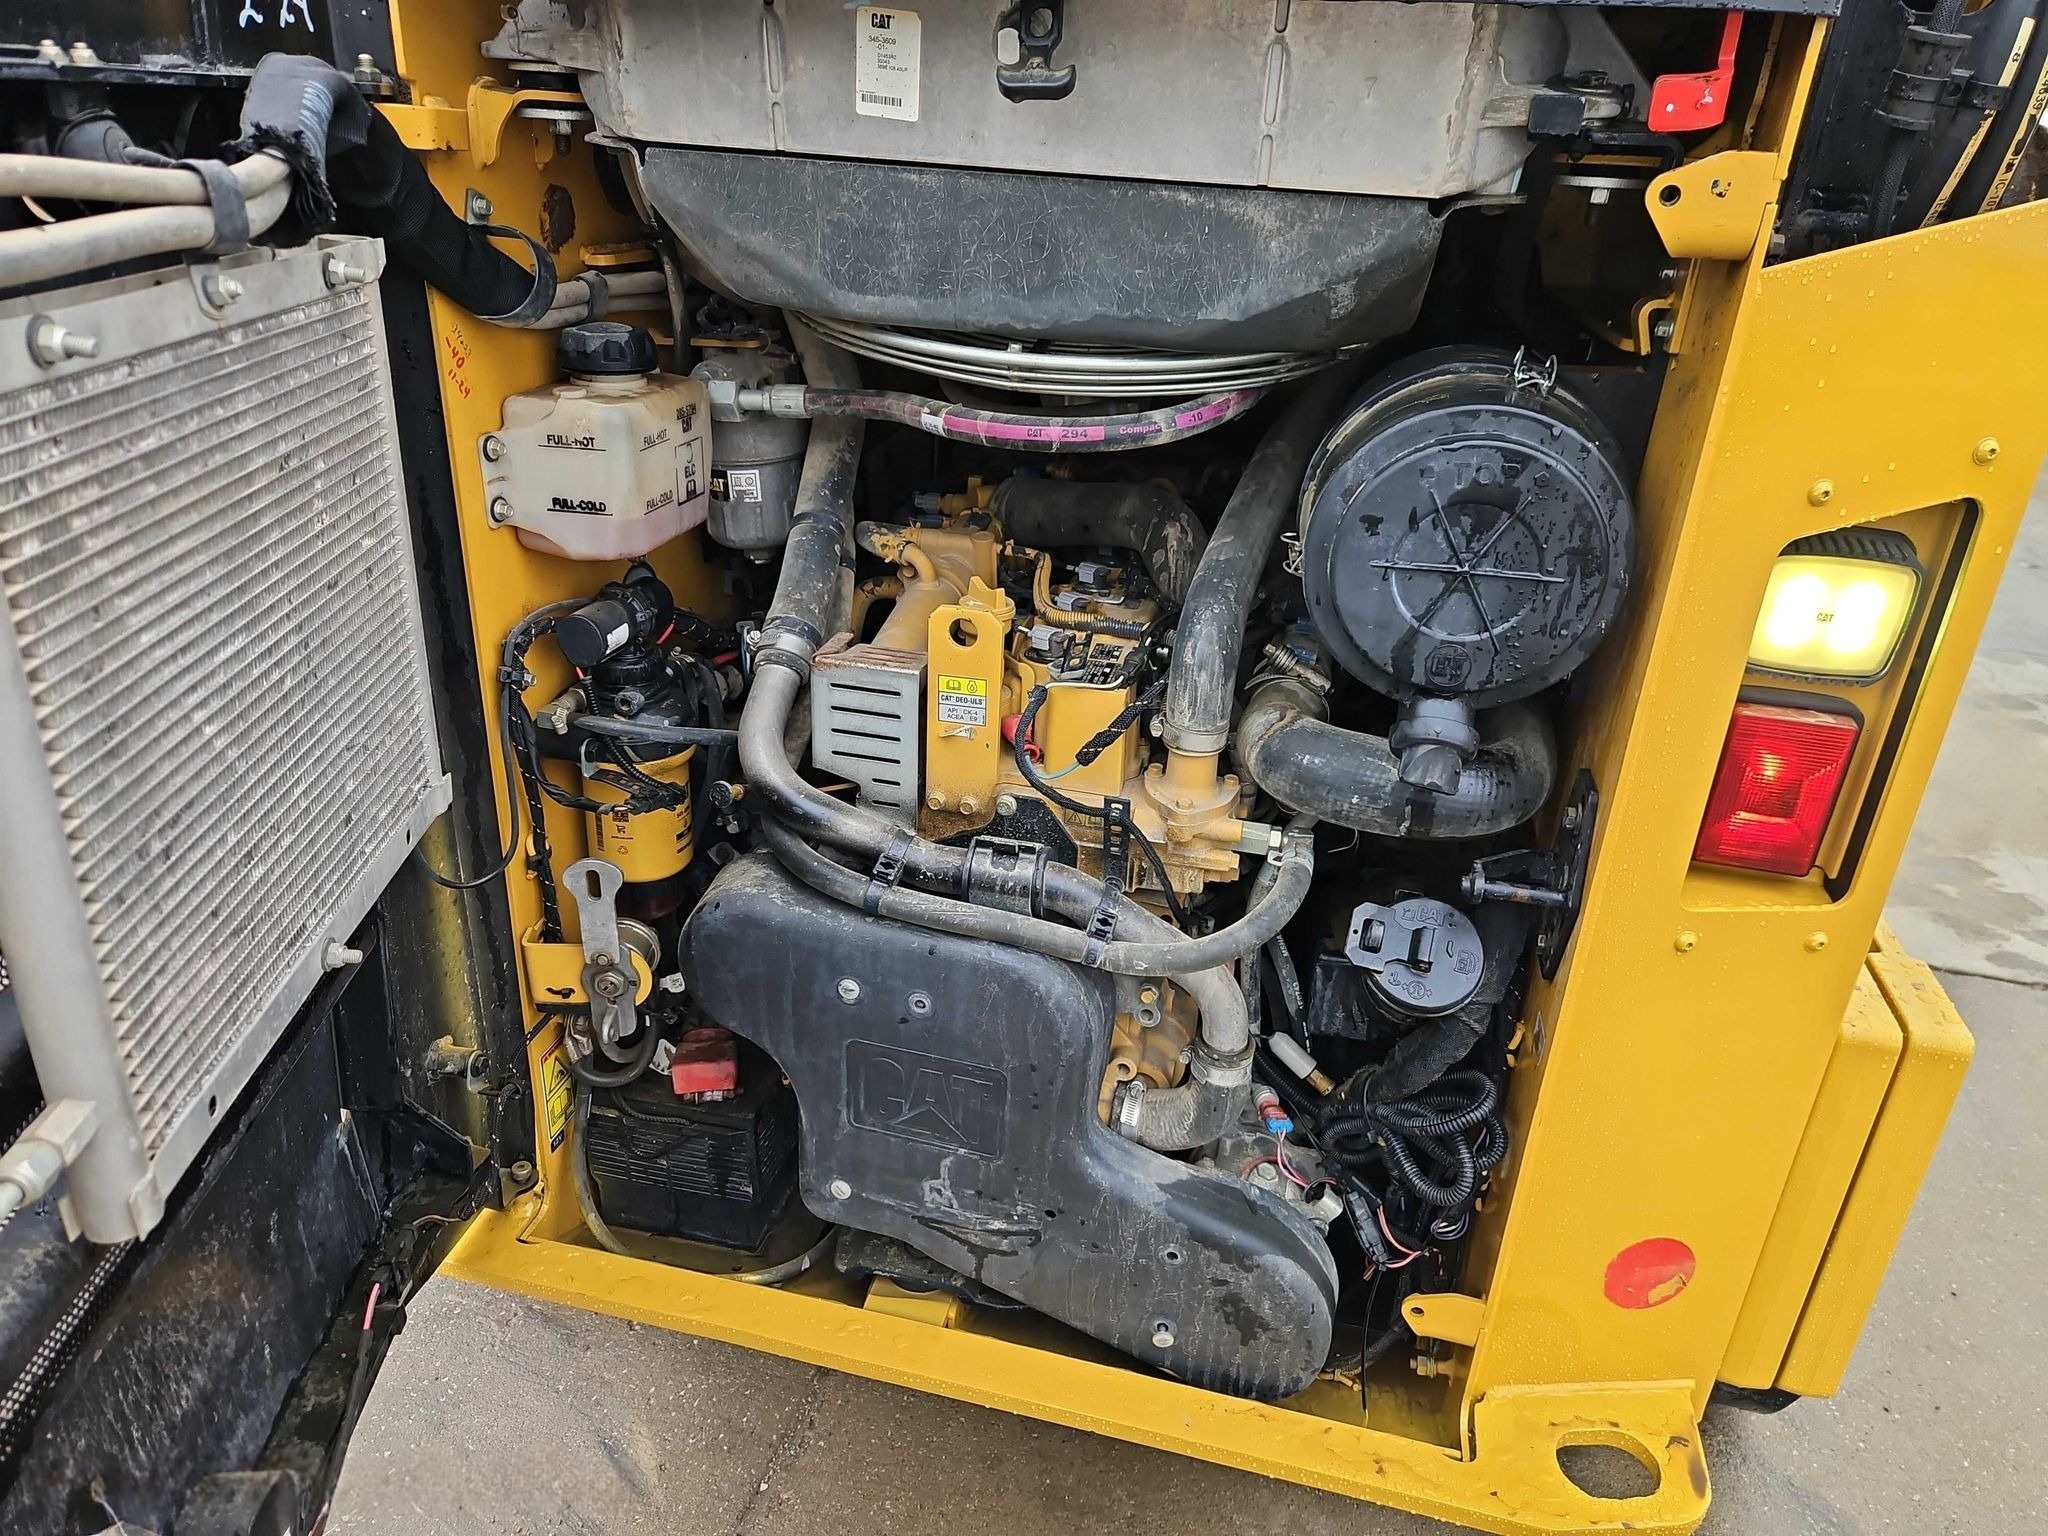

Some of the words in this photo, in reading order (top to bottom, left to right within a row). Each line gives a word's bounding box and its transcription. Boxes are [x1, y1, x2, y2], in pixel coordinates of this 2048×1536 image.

[871, 13, 892, 30] CAT
[867, 35, 897, 46] 345-3609
[1188, 411, 1203, 423] -10
[546, 434, 596, 448] FULL-HOT
[643, 429, 667, 446] FULL-HOT
[1027, 428, 1044, 438] CAT
[1061, 429, 1088, 439] 294
[685, 464, 696, 479] ELC
[1453, 460, 1521, 488] TOP
[551, 496, 607, 512] FULL-COLD
[646, 489, 674, 511] FULL-COLD
[1817, 612, 1835, 623] CAT
[940, 694, 953, 702] CAT
[955, 696, 983, 705] DEO-ULS
[859, 1056, 994, 1145] CAT
